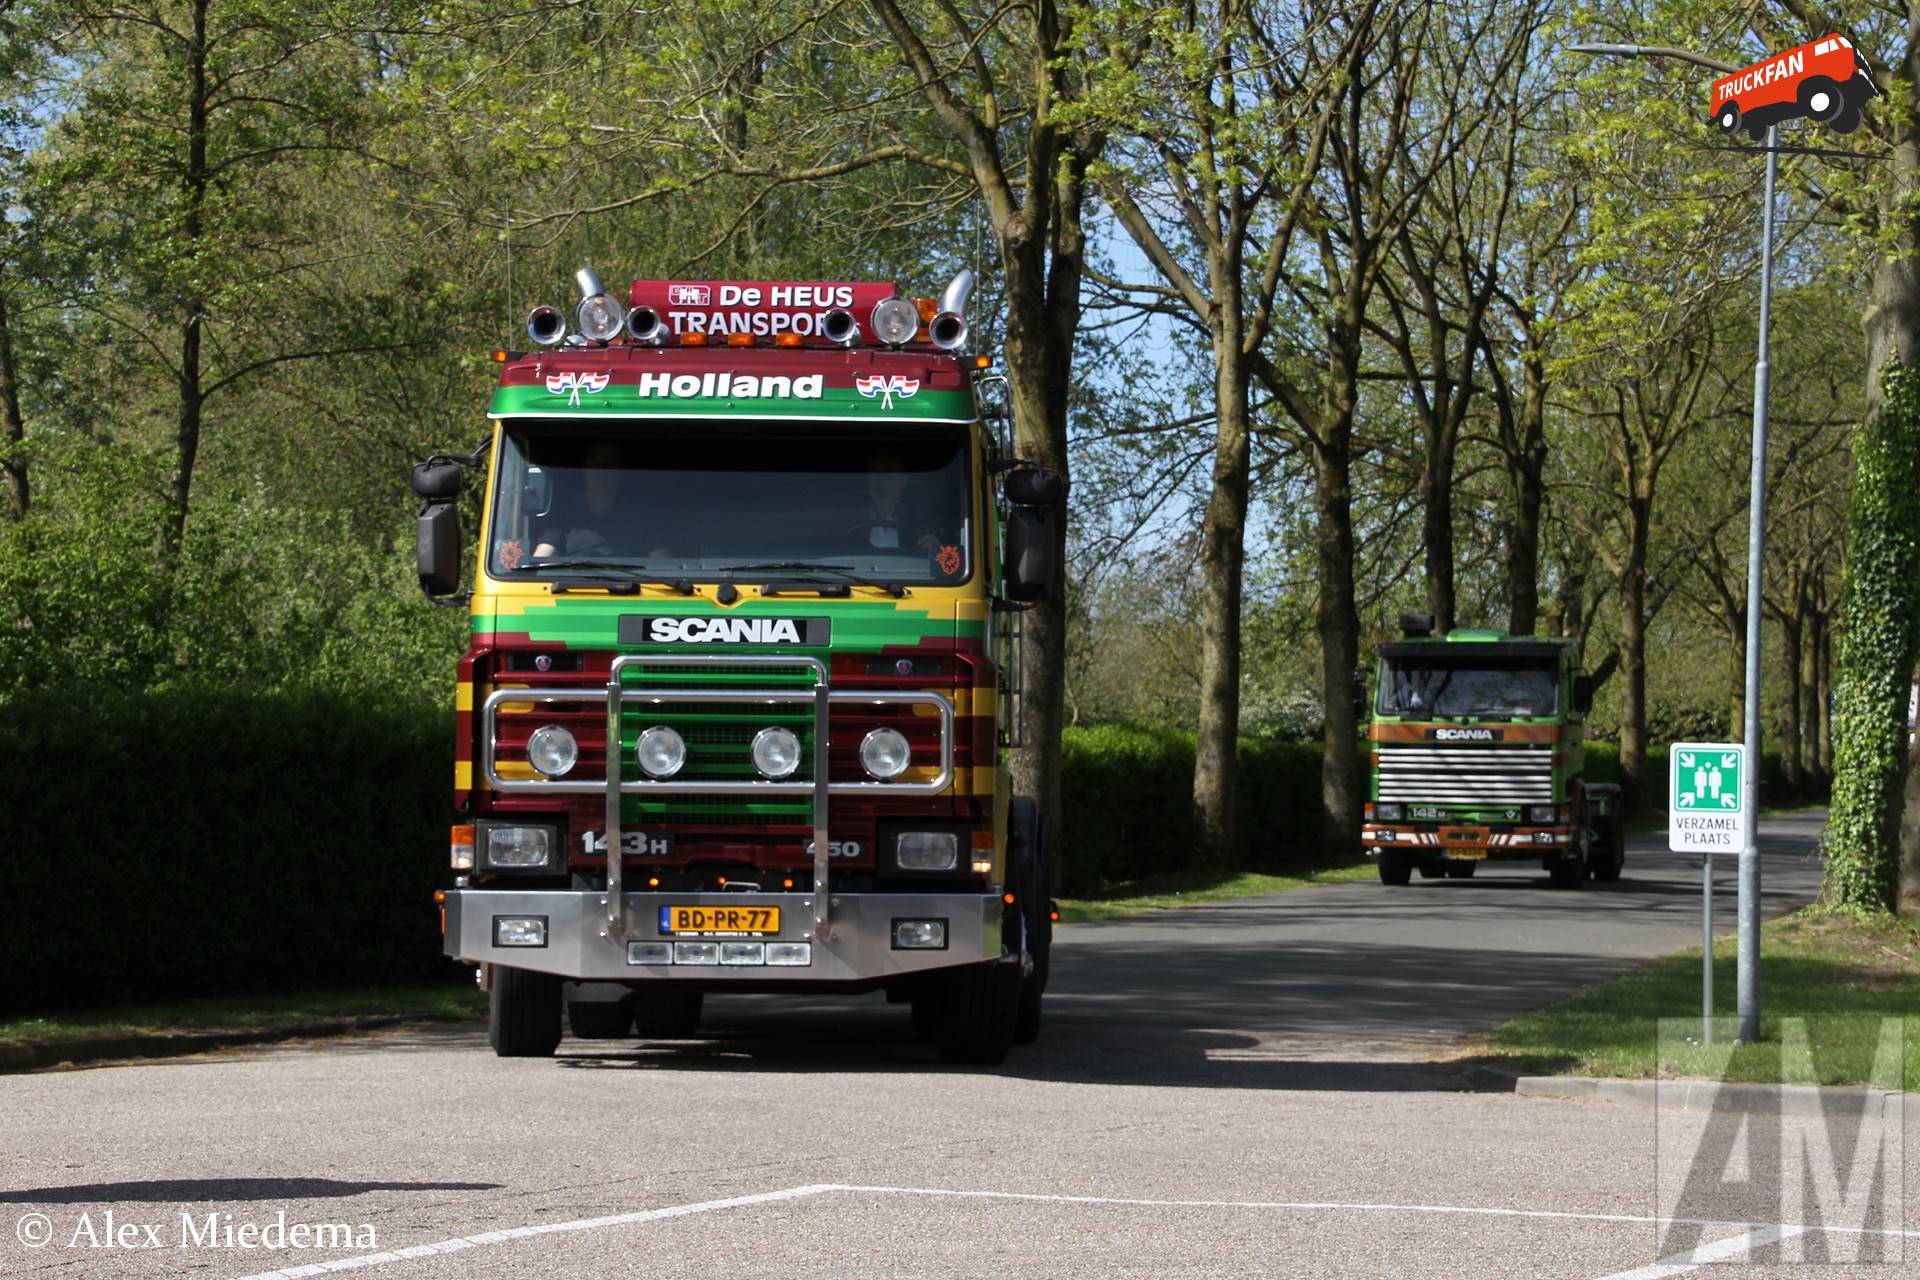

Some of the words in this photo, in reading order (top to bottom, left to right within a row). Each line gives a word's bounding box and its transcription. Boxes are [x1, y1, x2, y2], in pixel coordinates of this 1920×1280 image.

[719, 286, 761, 306] De
[771, 286, 853, 307] HEUS
[639, 373, 823, 399] Holland
[650, 617, 801, 643] SCANIA
[1436, 729, 1492, 740] SCANIA
[1676, 817, 1740, 831] VERZAMEL
[1684, 832, 1731, 845] PLAATS
[678, 910, 771, 929] BD-PR-77
